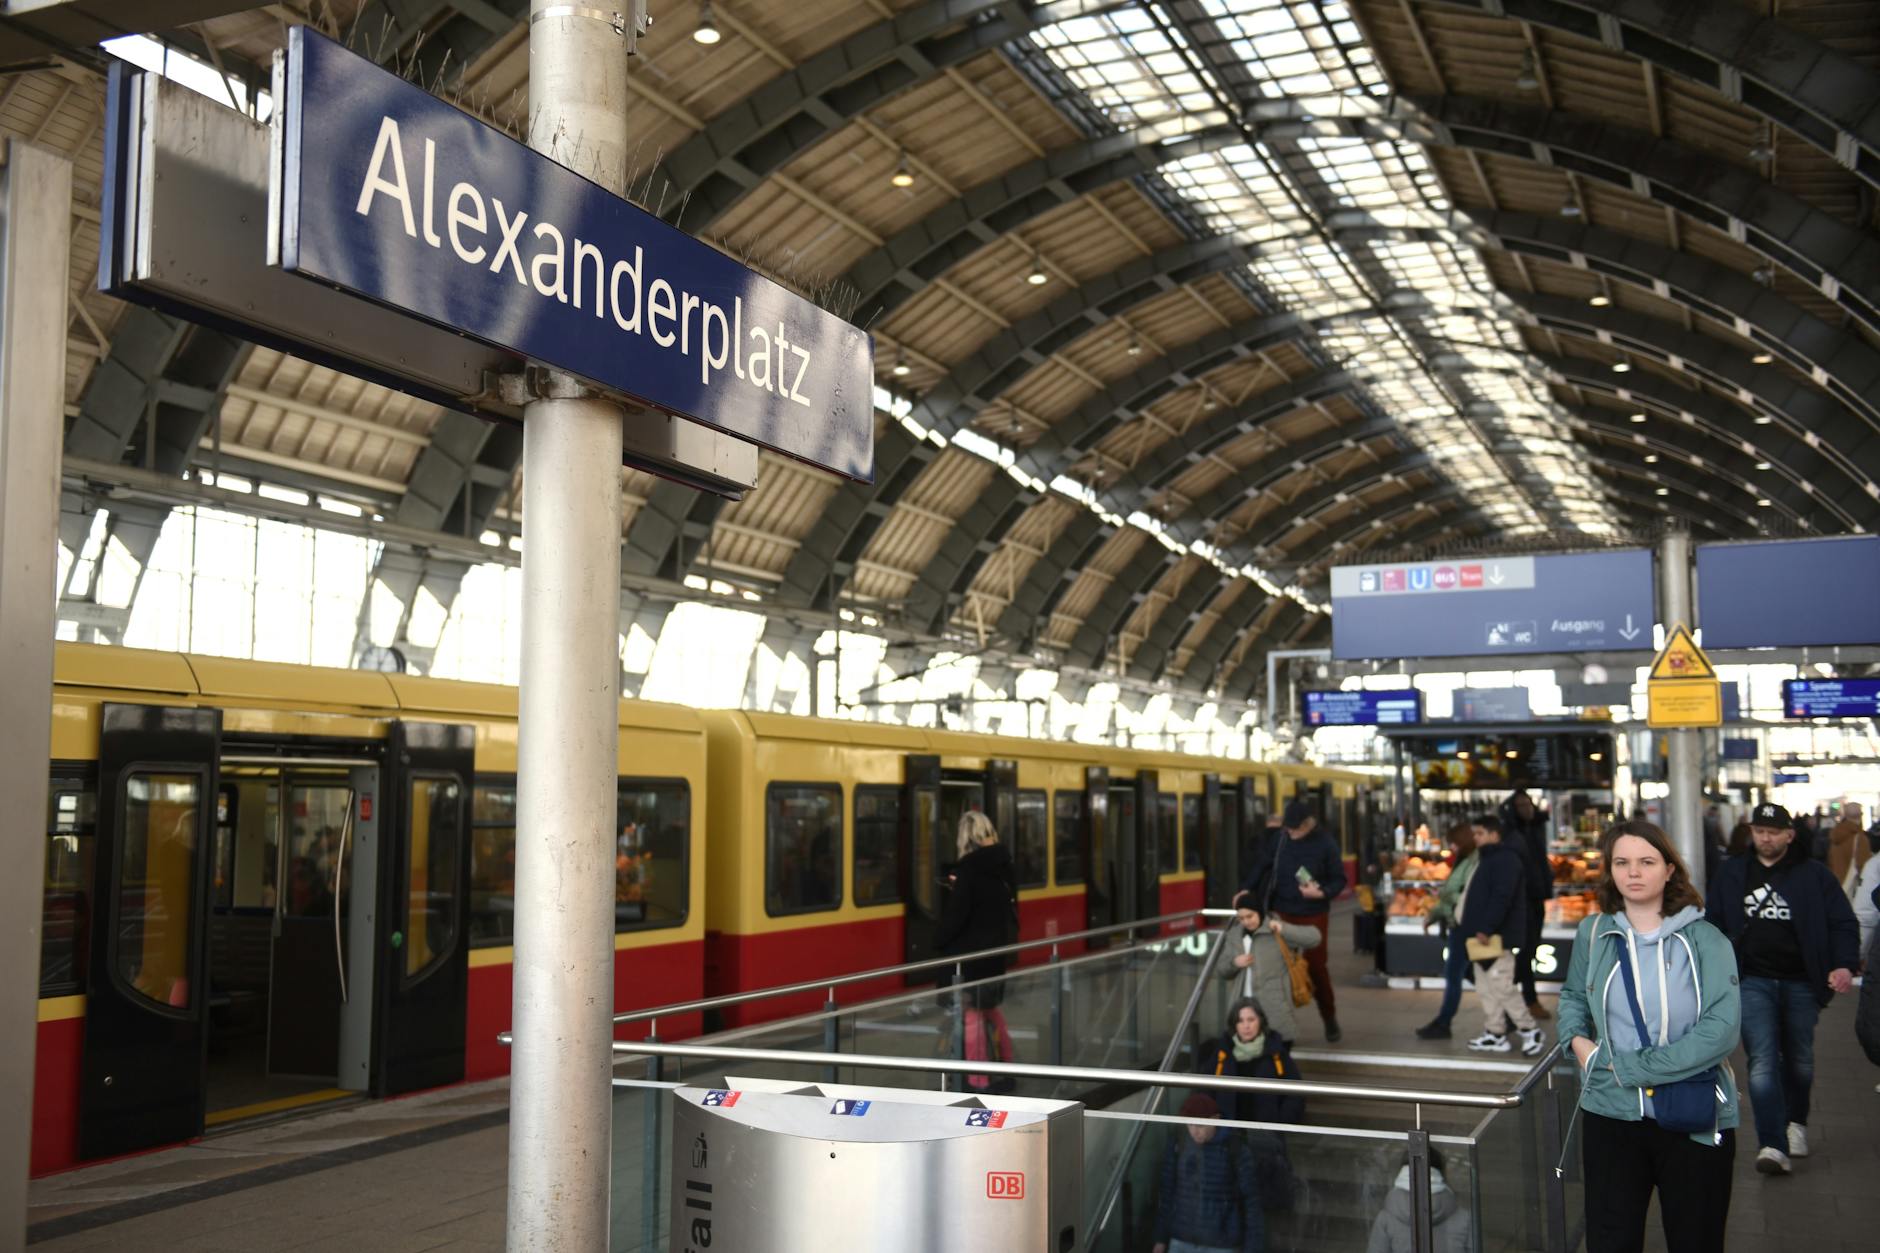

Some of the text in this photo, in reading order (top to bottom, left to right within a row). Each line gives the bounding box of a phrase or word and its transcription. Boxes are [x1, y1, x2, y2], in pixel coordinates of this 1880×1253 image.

[355, 116, 811, 407] Alexanderplatz
[1411, 568, 1427, 588] U
[1551, 619, 1605, 634] Ausgang
[991, 1175, 1021, 1196] DB
[685, 1180, 712, 1253] all
